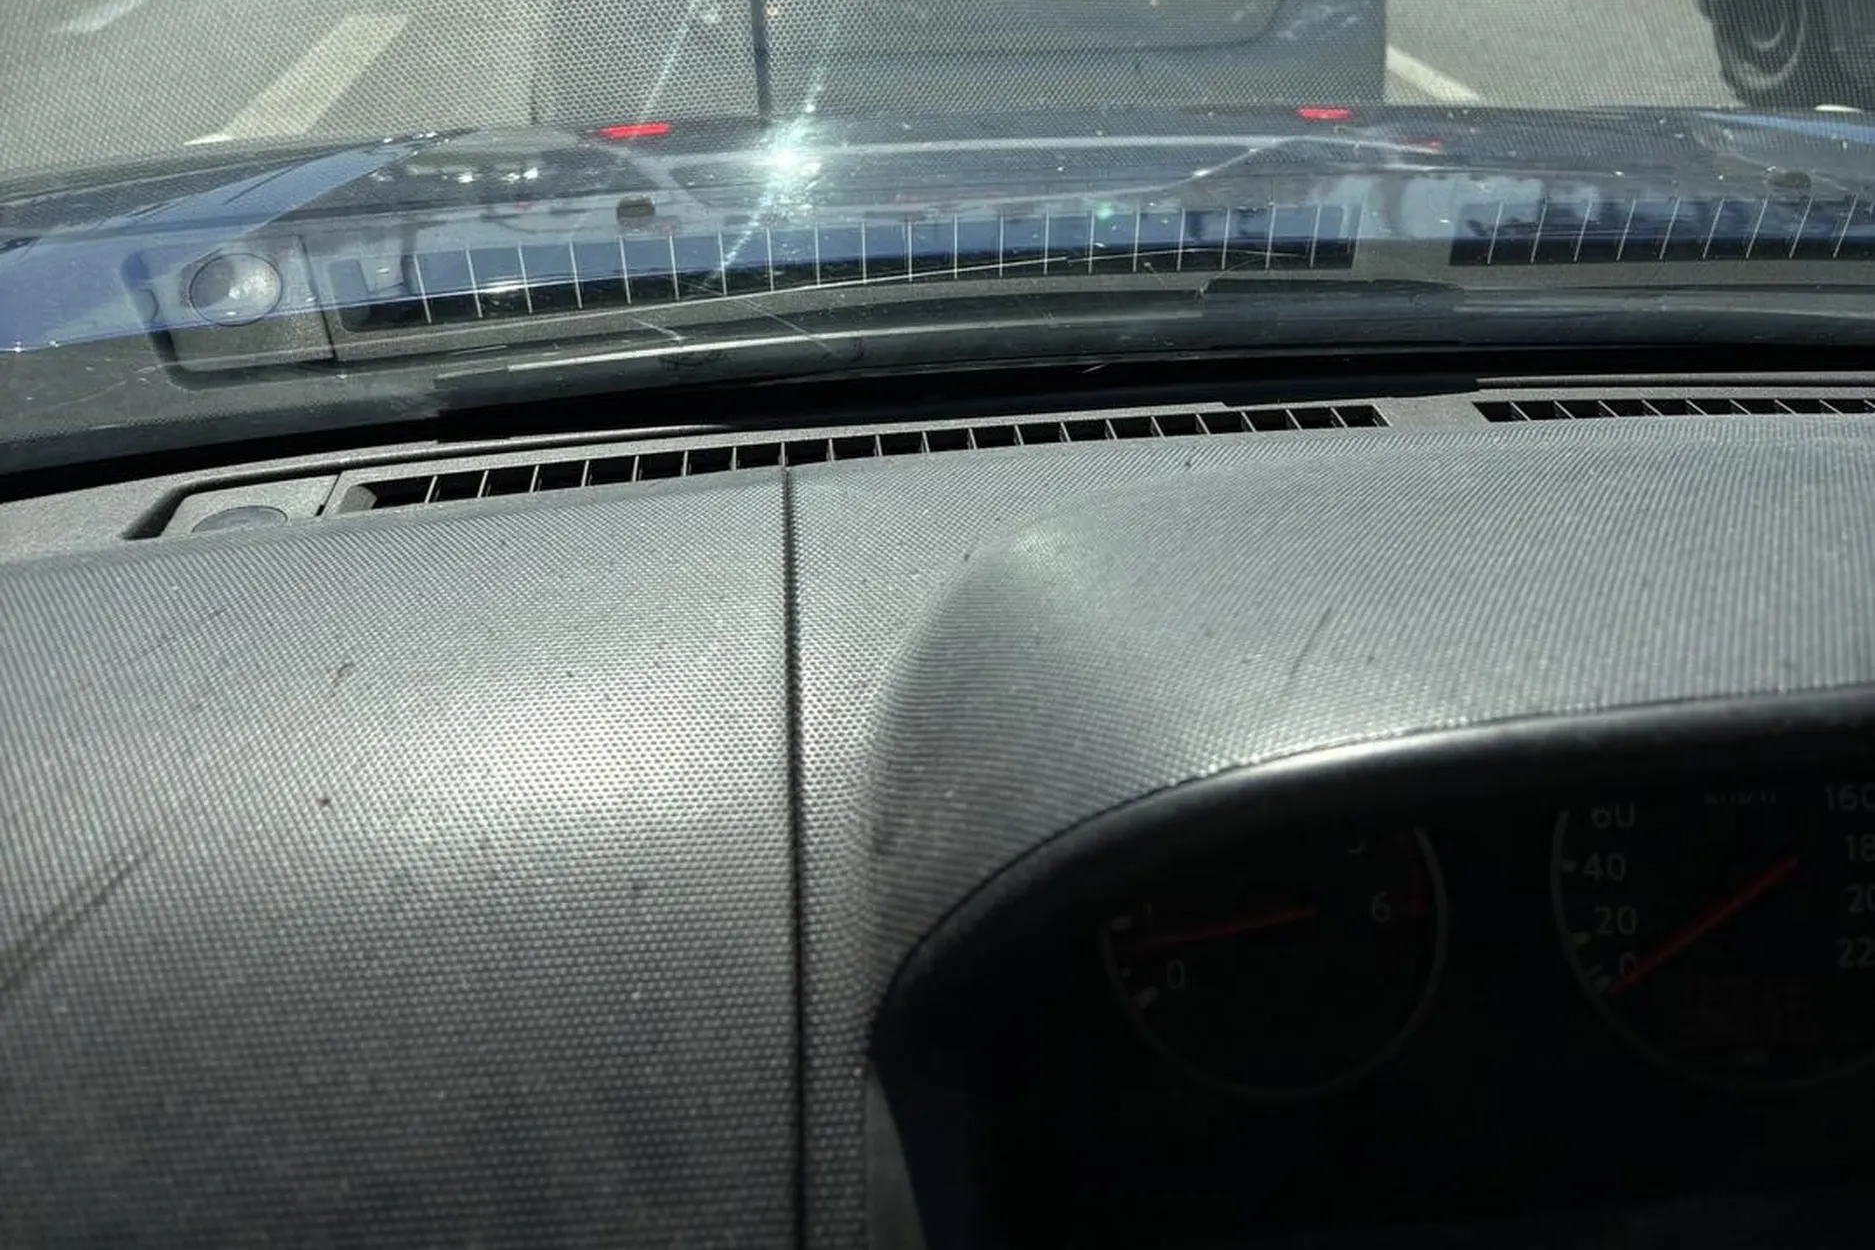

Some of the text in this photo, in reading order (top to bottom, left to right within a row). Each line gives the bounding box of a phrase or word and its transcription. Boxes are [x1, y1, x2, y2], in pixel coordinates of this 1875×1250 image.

[1582, 851, 1627, 882] 40
[1370, 890, 1391, 923] 6
[1594, 904, 1639, 936] 20
[1166, 958, 1186, 990] 0
